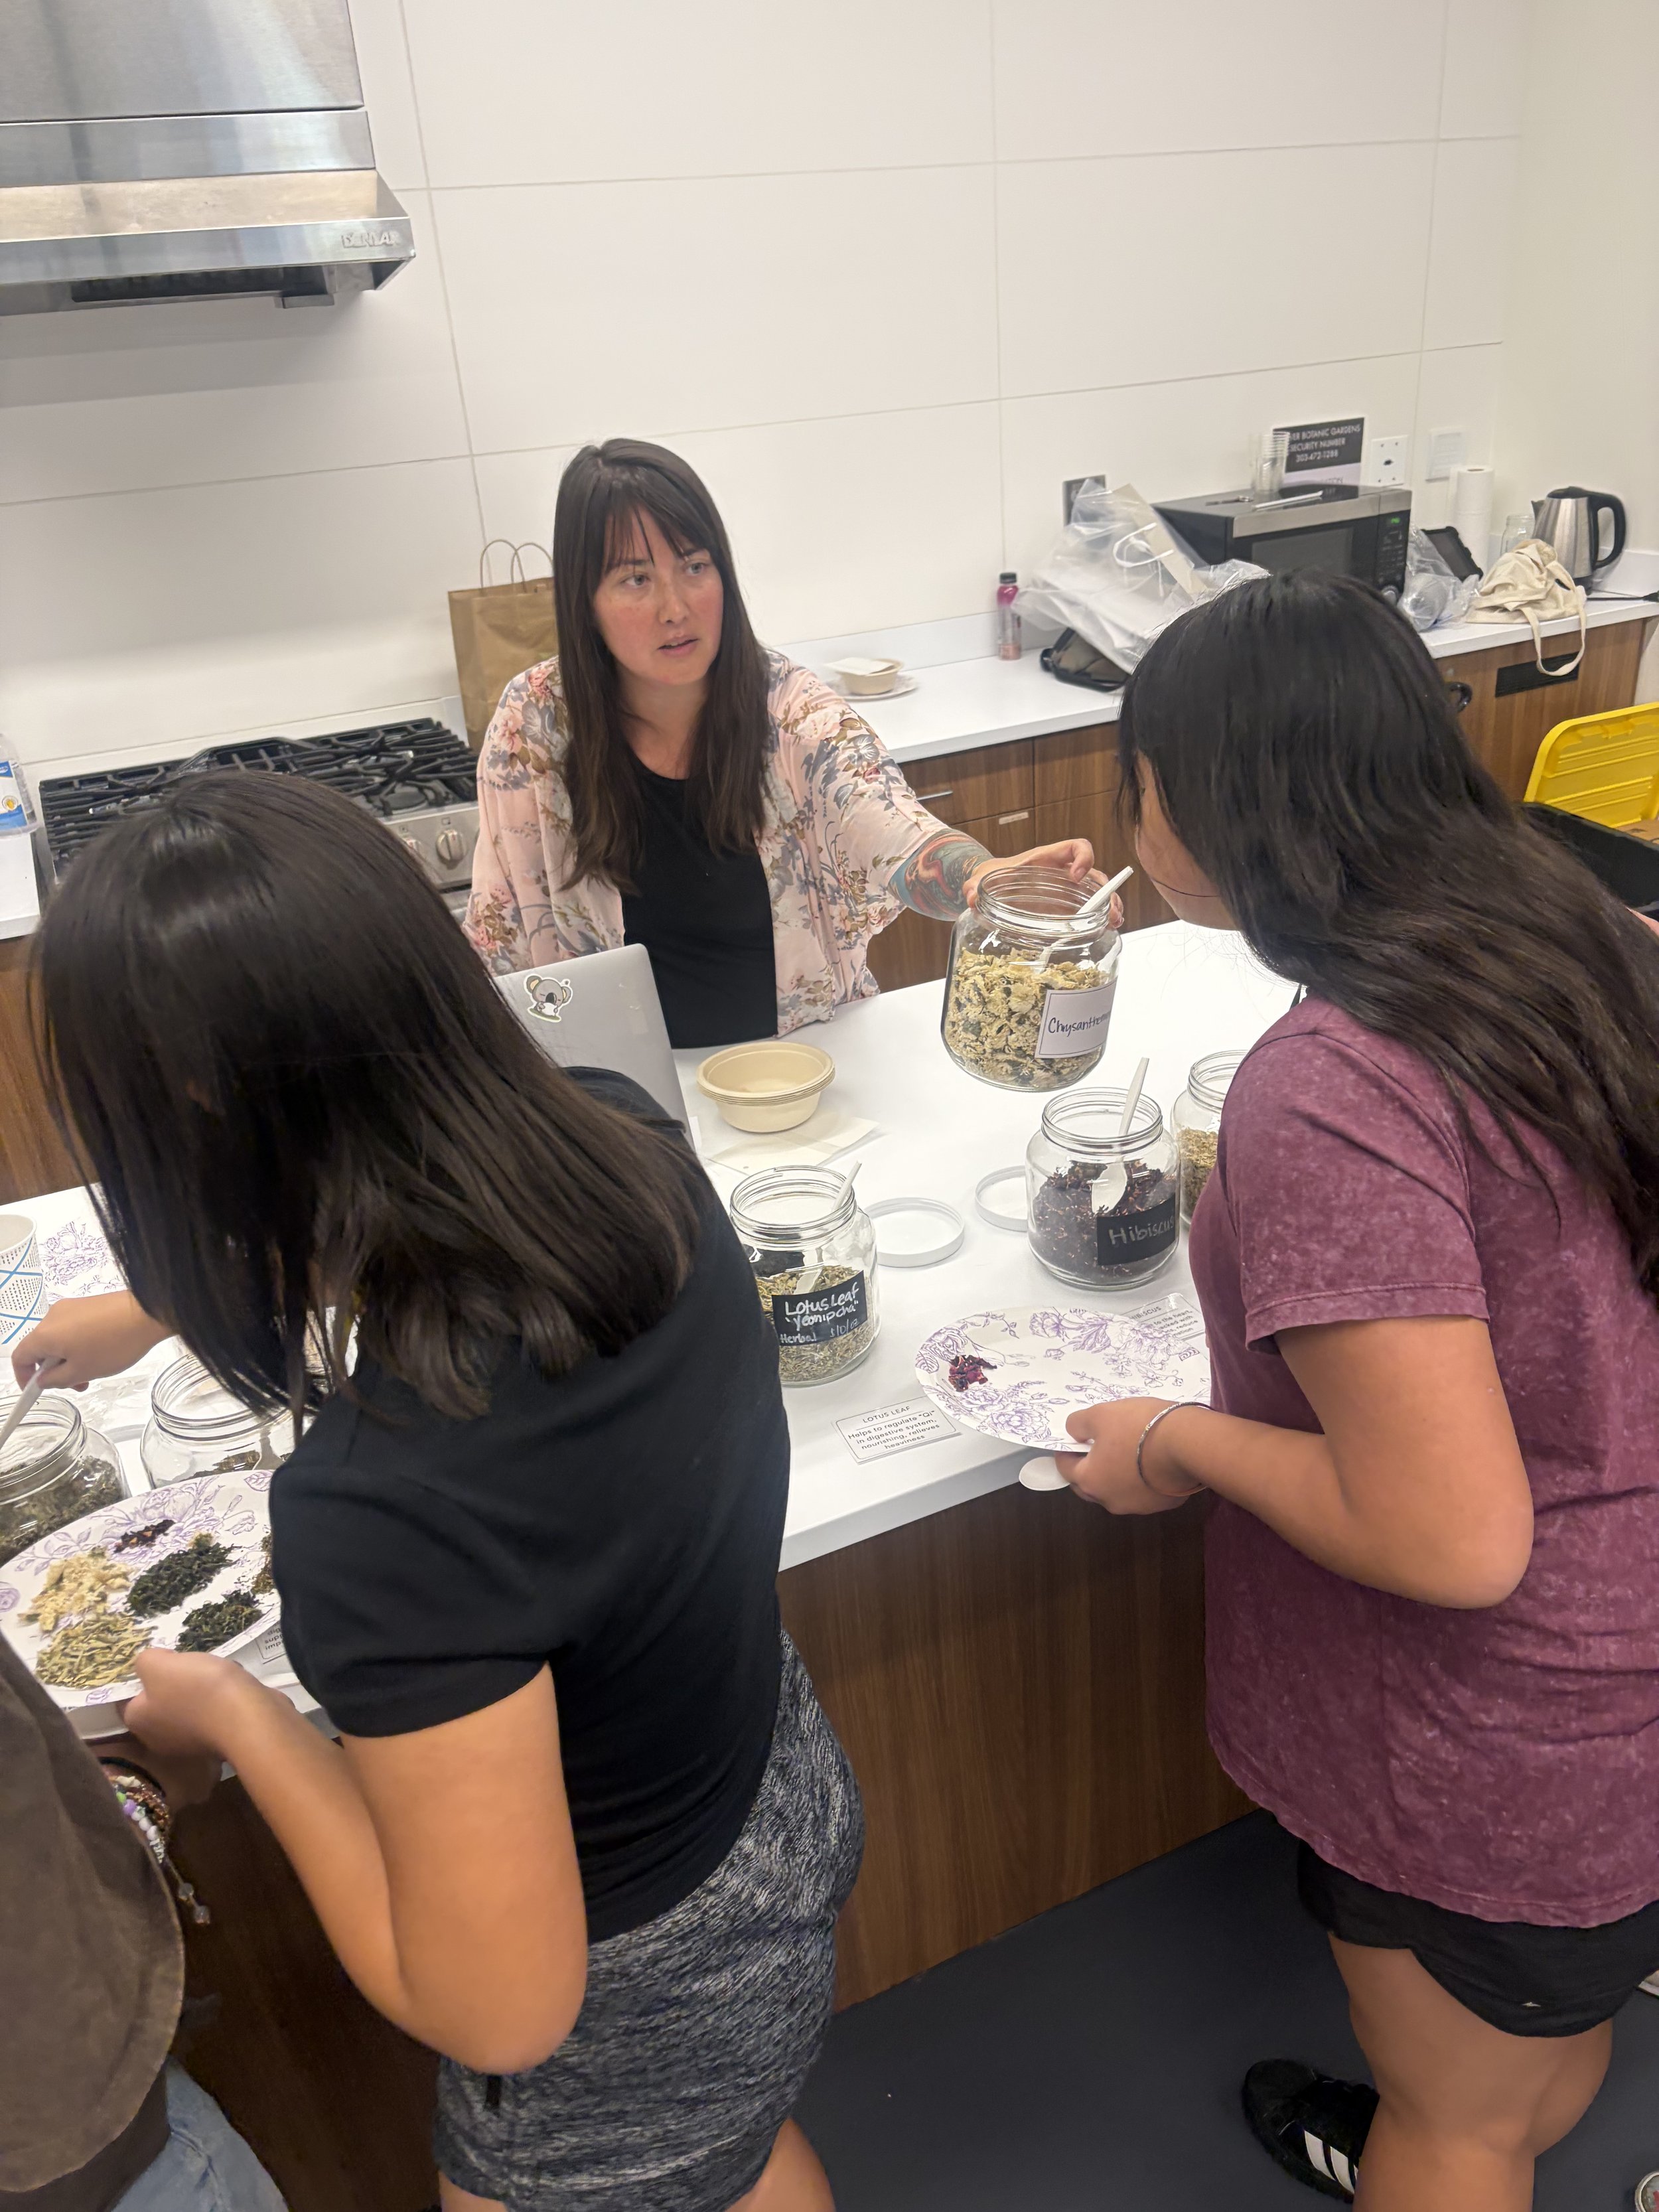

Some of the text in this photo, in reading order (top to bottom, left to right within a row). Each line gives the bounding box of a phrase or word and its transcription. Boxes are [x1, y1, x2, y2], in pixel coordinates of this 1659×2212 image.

[1301, 428, 1329, 440] BOTANIC
[1331, 423, 1361, 436] GARDENS
[1320, 437, 1345, 449] NUMBER
[1109, 1216, 1174, 1245] Hibiscus
[785, 1282, 859, 1315] Lotus Leaf
[780, 1332, 817, 1344] Herbal
[862, 1406, 911, 1424] LOTUS LEAF
[847, 1428, 872, 1439] Helps
[884, 1416, 917, 1430] regulate
[861, 1424, 940, 1450] nourishing, relieves
[866, 1428, 904, 1441] digestive
[905, 1419, 937, 1431] system,
[884, 1434, 926, 1449] heaviness
